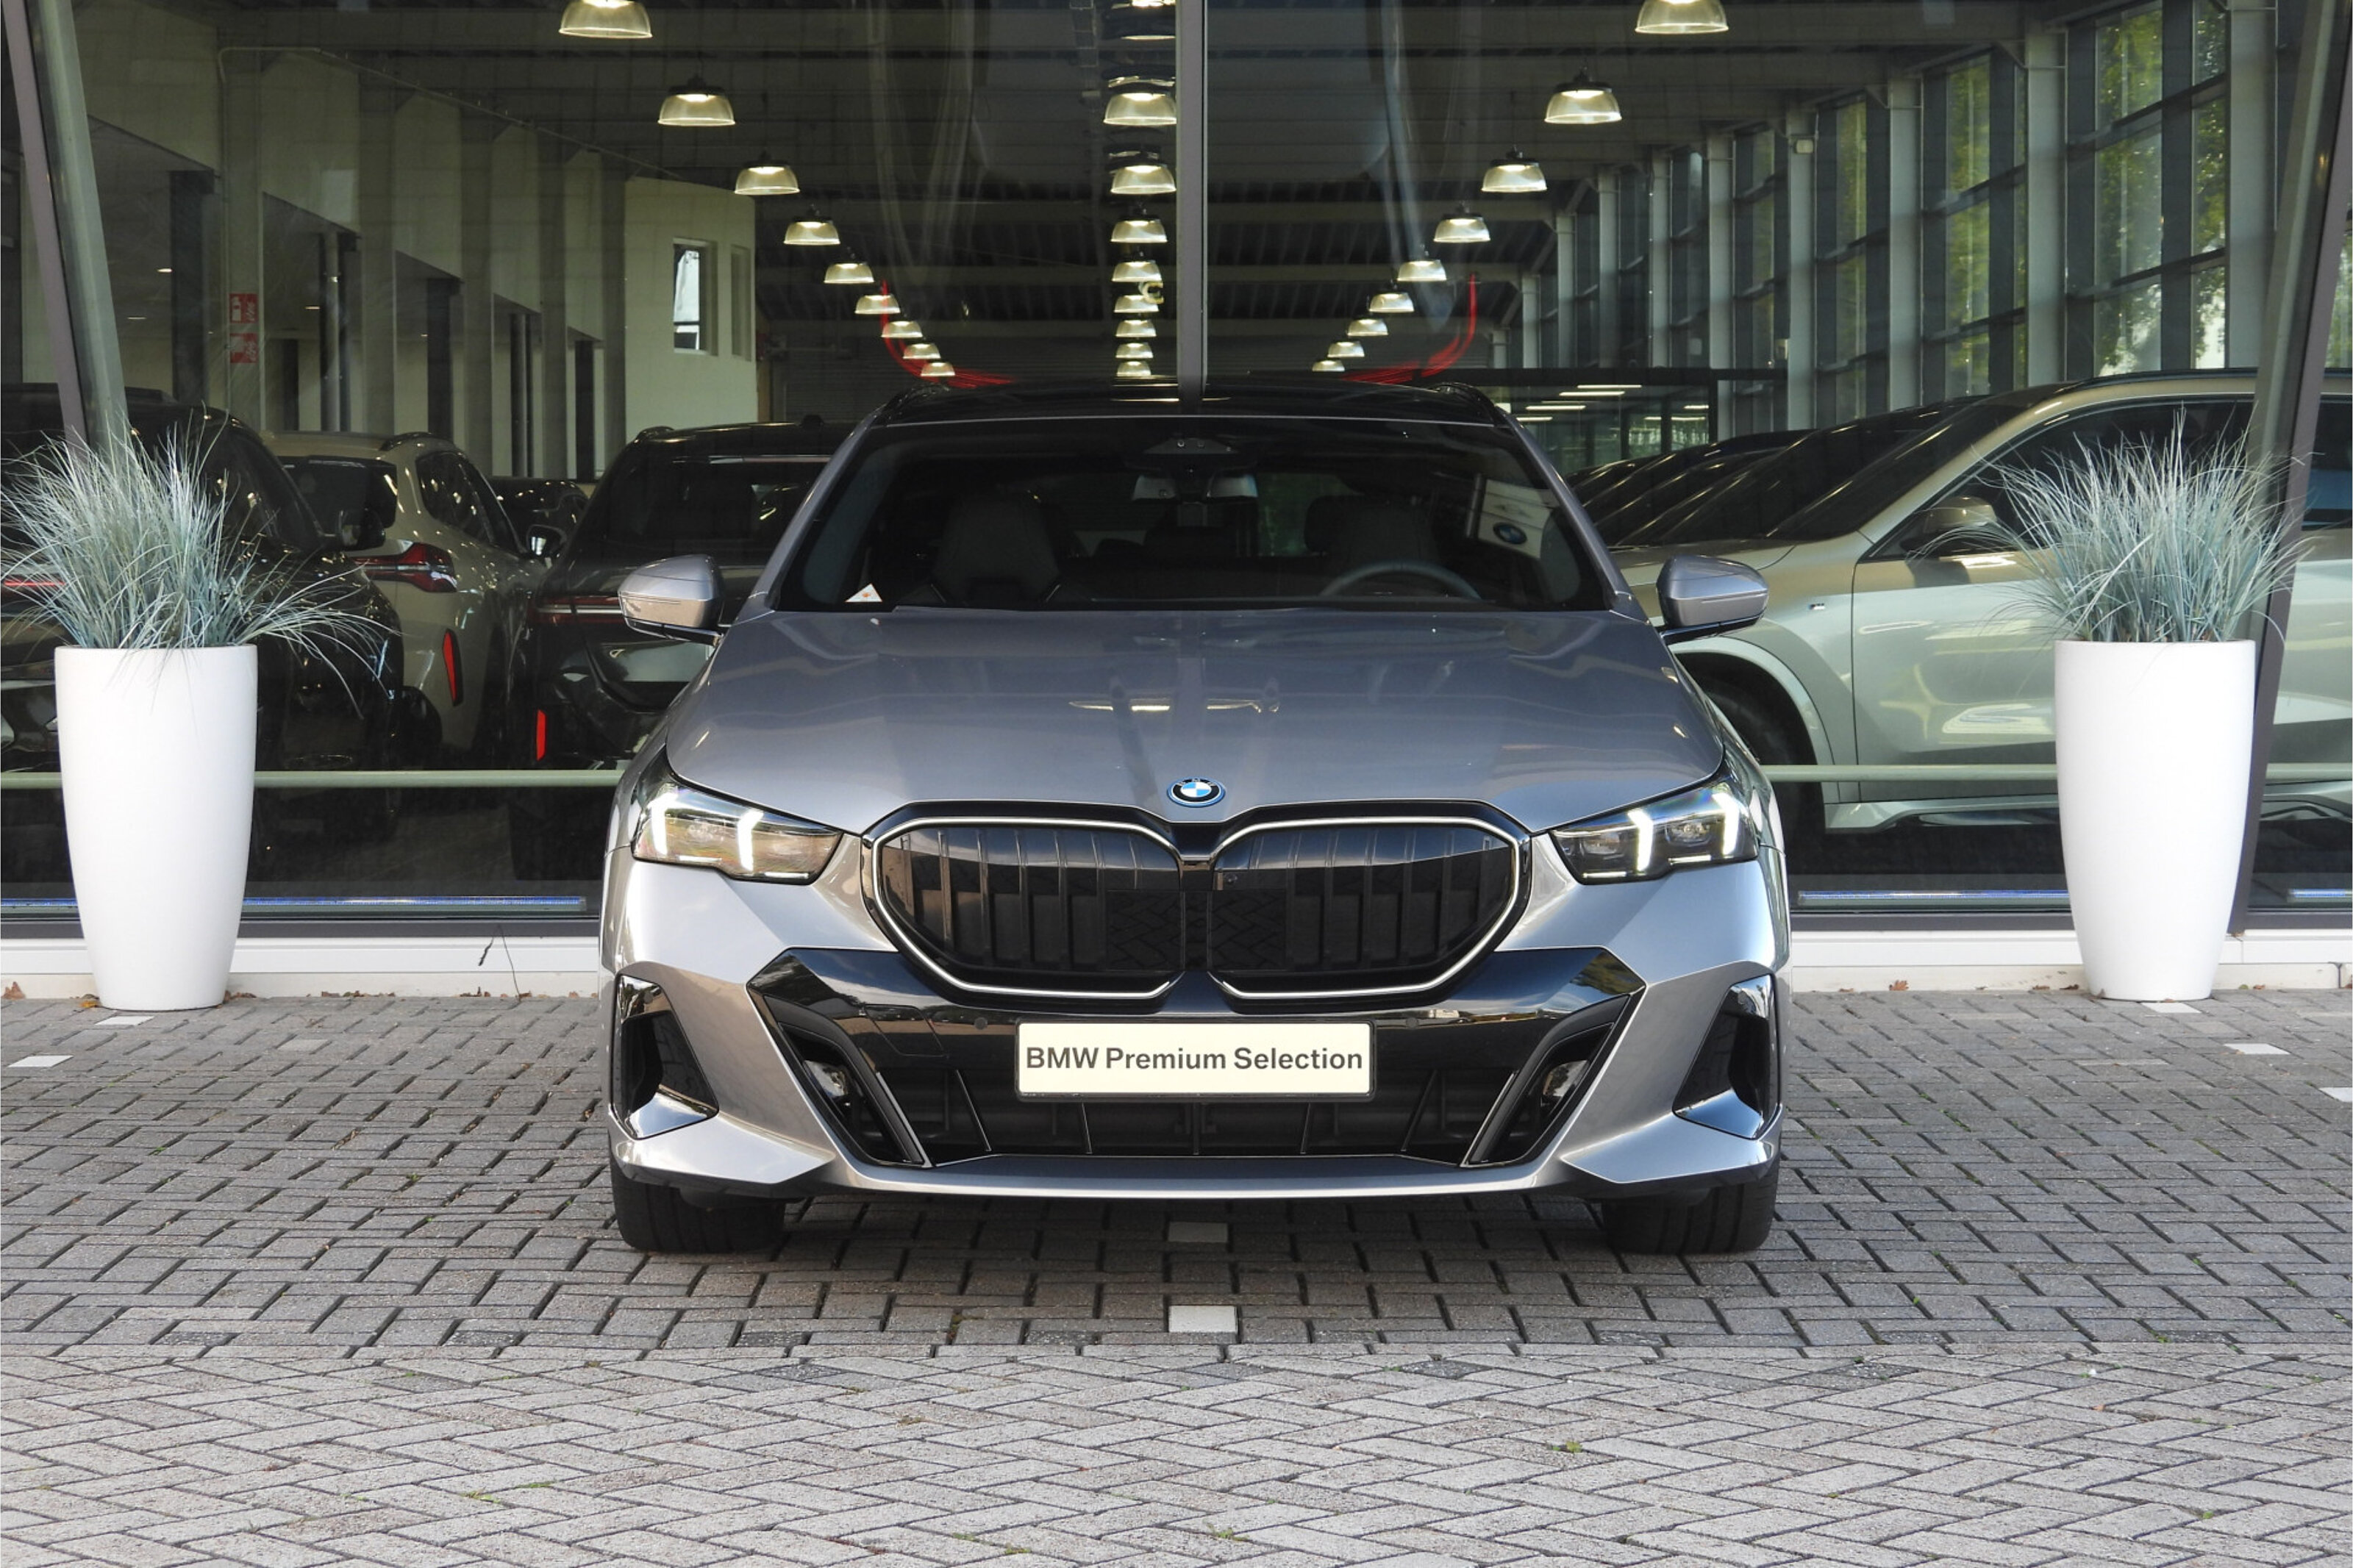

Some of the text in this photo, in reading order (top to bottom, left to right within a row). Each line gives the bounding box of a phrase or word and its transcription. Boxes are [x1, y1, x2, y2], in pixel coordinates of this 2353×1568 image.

[1026, 1047, 1363, 1070] BMW Premium Selection
